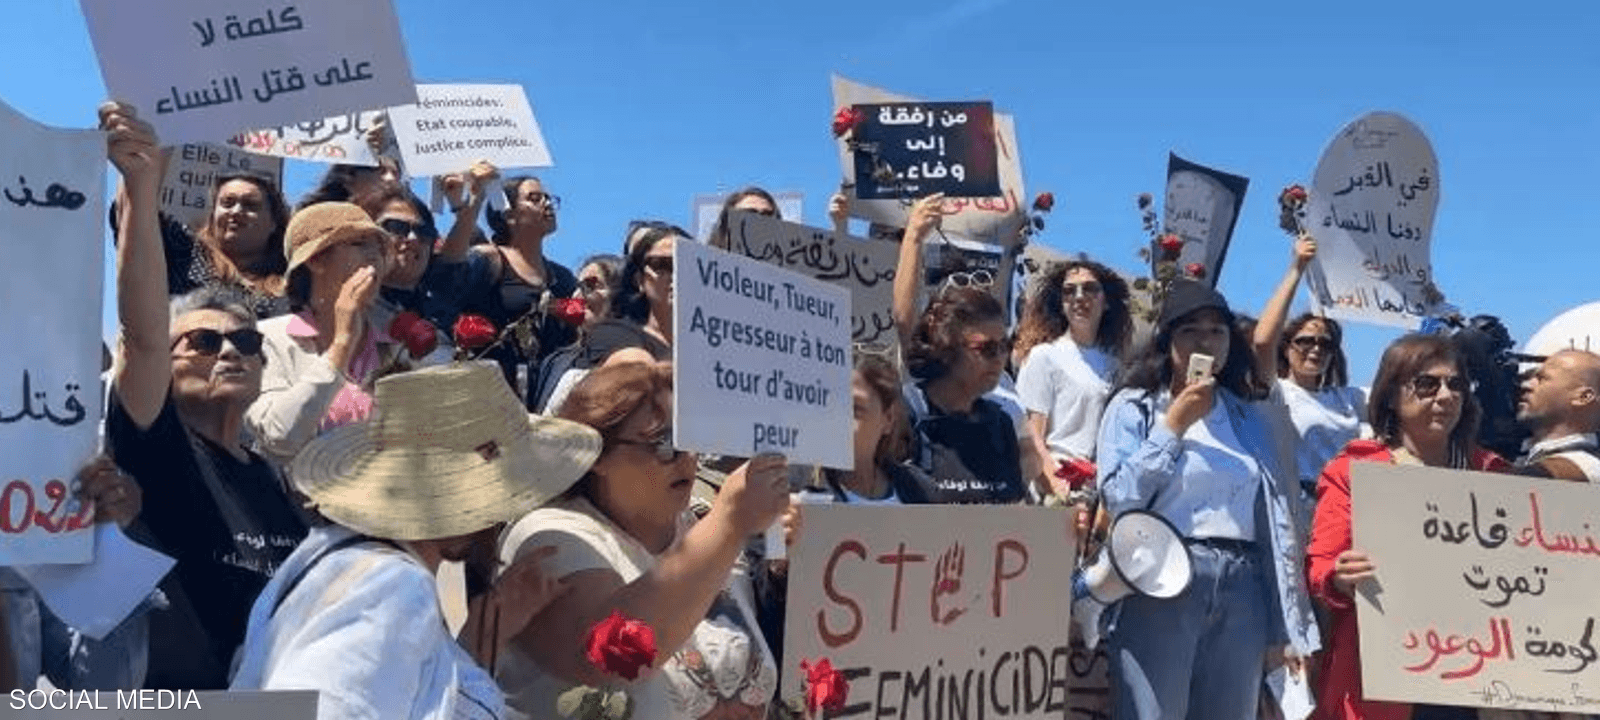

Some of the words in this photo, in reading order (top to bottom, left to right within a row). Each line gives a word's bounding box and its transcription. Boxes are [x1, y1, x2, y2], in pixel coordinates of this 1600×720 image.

[192, 18, 215, 47] لا
[224, 6, 303, 41] كلمة
[253, 66, 306, 103] قتل
[313, 58, 373, 86] على
[156, 75, 243, 114] النساء
[450, 116, 517, 130] coupable,
[878, 106, 934, 128] رفقة
[939, 110, 968, 127] من
[182, 144, 220, 165] Elle
[416, 138, 465, 154] Justice
[906, 134, 945, 156] إلى
[180, 170, 216, 188] qui
[1333, 161, 1393, 196] القبر
[1400, 168, 1430, 207] في
[182, 192, 205, 209] La
[1322, 204, 1378, 234] النساء
[697, 257, 779, 311] Violeur,
[783, 282, 839, 327] Tueur,
[689, 306, 797, 354] Agresseur
[800, 329, 811, 358] à
[816, 336, 846, 367] ton
[0, 369, 86, 426] قتل
[714, 360, 762, 396] tour
[766, 370, 830, 407] d'avoir
[753, 422, 799, 453] peur
[1422, 491, 1508, 549] قاعدة
[1514, 490, 1600, 557] نساء
[1463, 565, 1549, 608] تموت
[1403, 617, 1515, 680] الوعود
